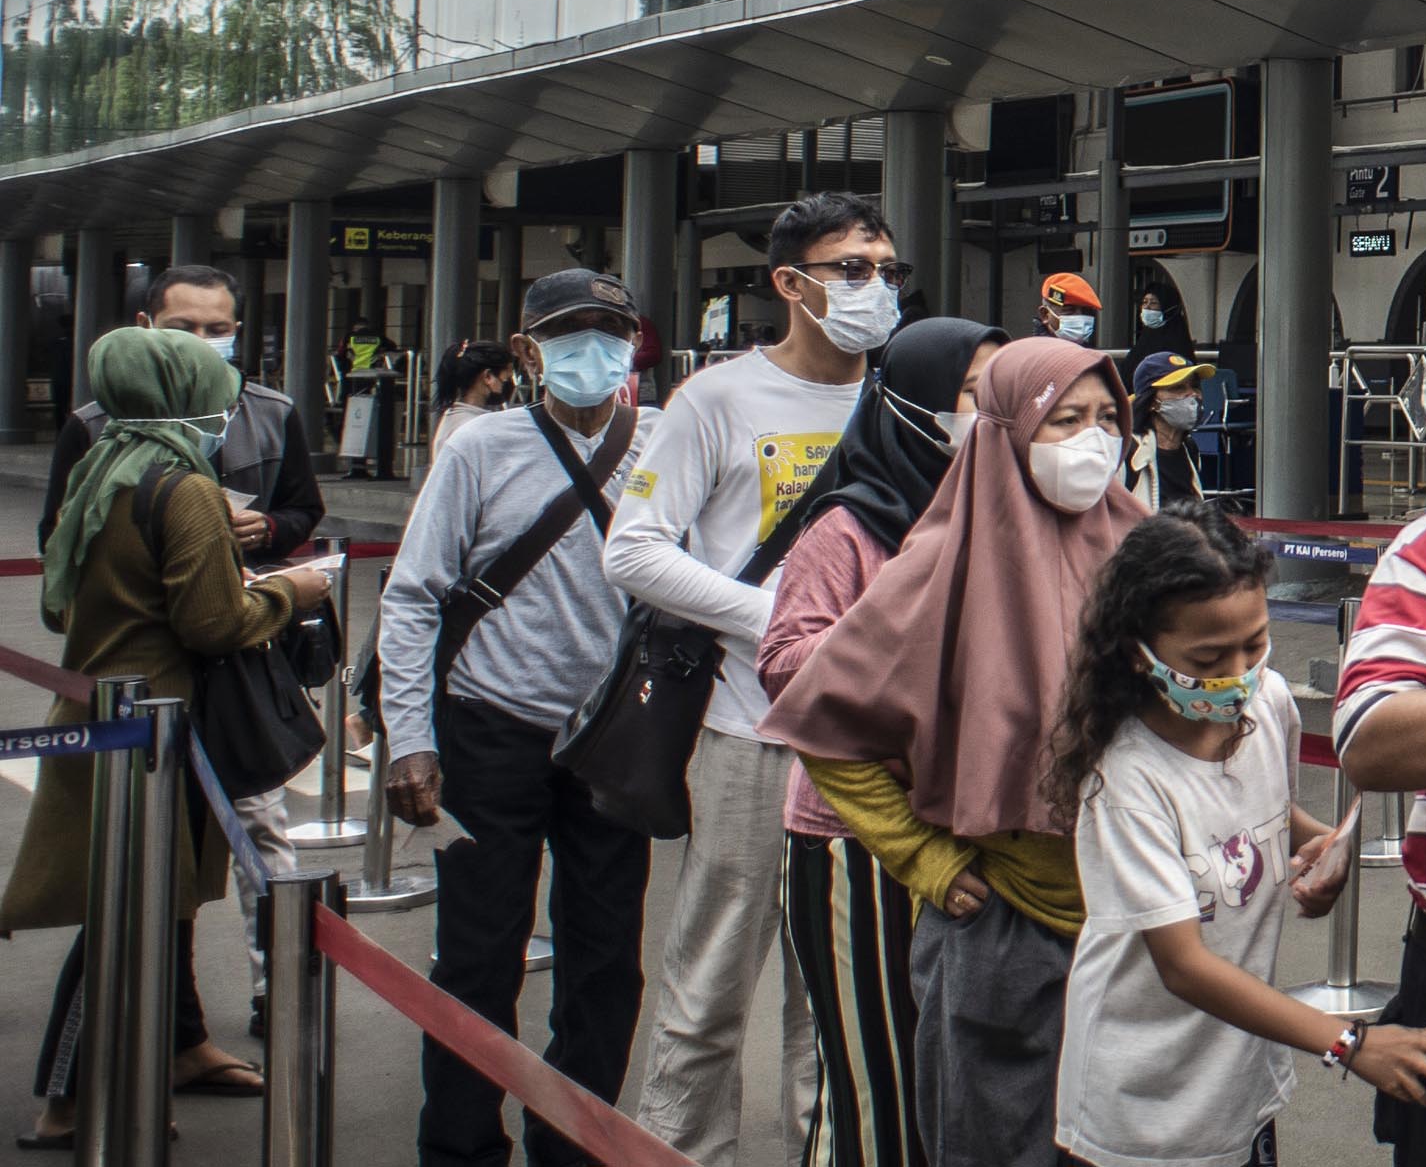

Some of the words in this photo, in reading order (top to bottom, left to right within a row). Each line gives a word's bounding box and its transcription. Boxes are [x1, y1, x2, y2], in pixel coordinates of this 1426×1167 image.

[1376, 166, 1389, 198] 2
[1352, 235, 1390, 251] SERAYU
[1284, 544, 1295, 554] PT
[1296, 545, 1310, 556] KAI
[1312, 546, 1348, 561] (Persero)
